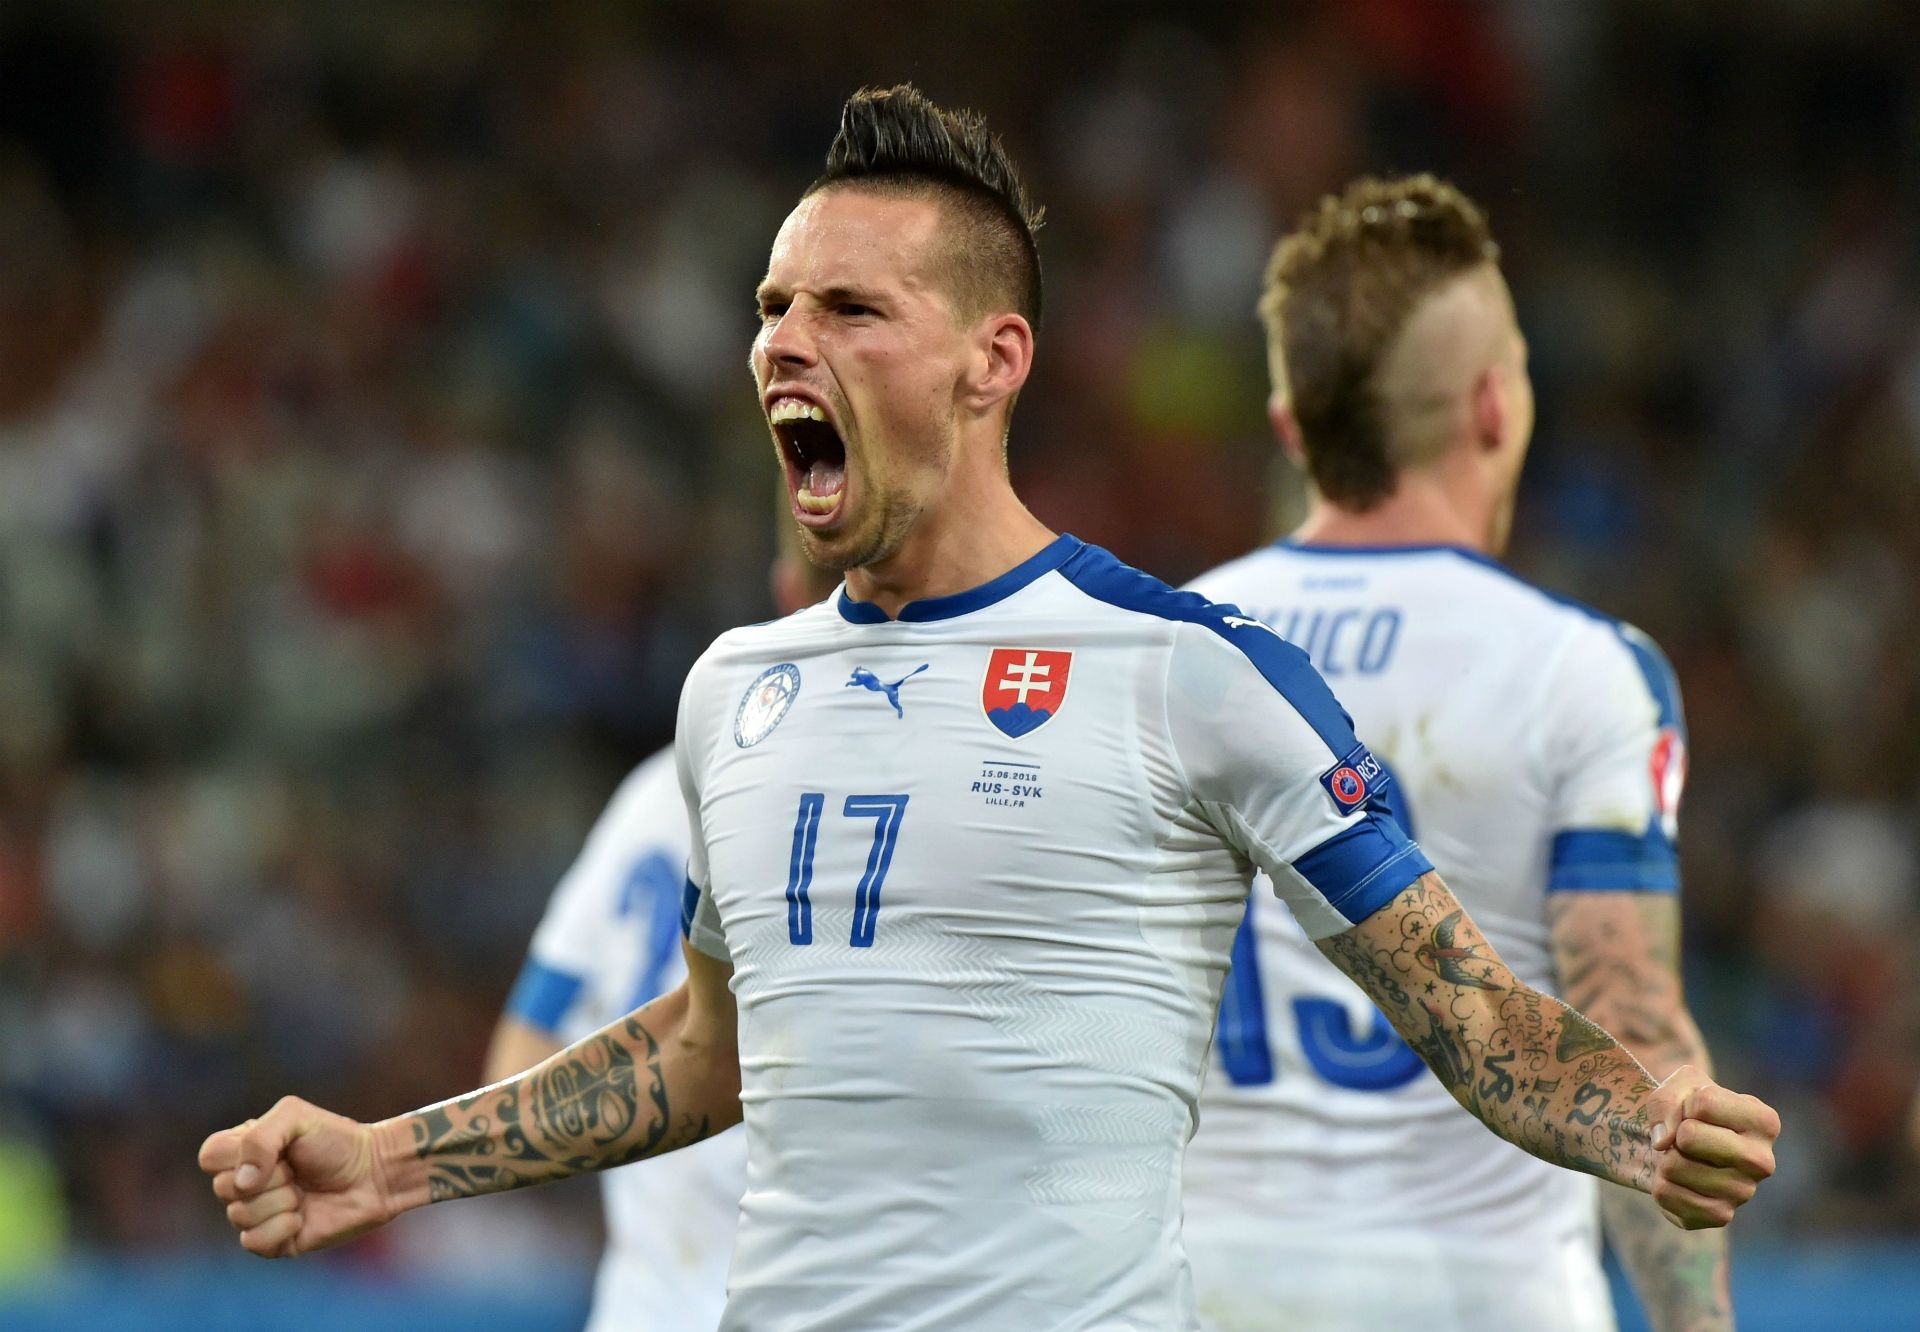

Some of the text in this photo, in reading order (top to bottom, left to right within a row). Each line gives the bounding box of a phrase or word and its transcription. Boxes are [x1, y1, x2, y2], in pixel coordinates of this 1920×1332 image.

[982, 770, 1037, 782] 15.06.2016
[1334, 770, 1350, 784] UEFA
[786, 793, 909, 947] 17
